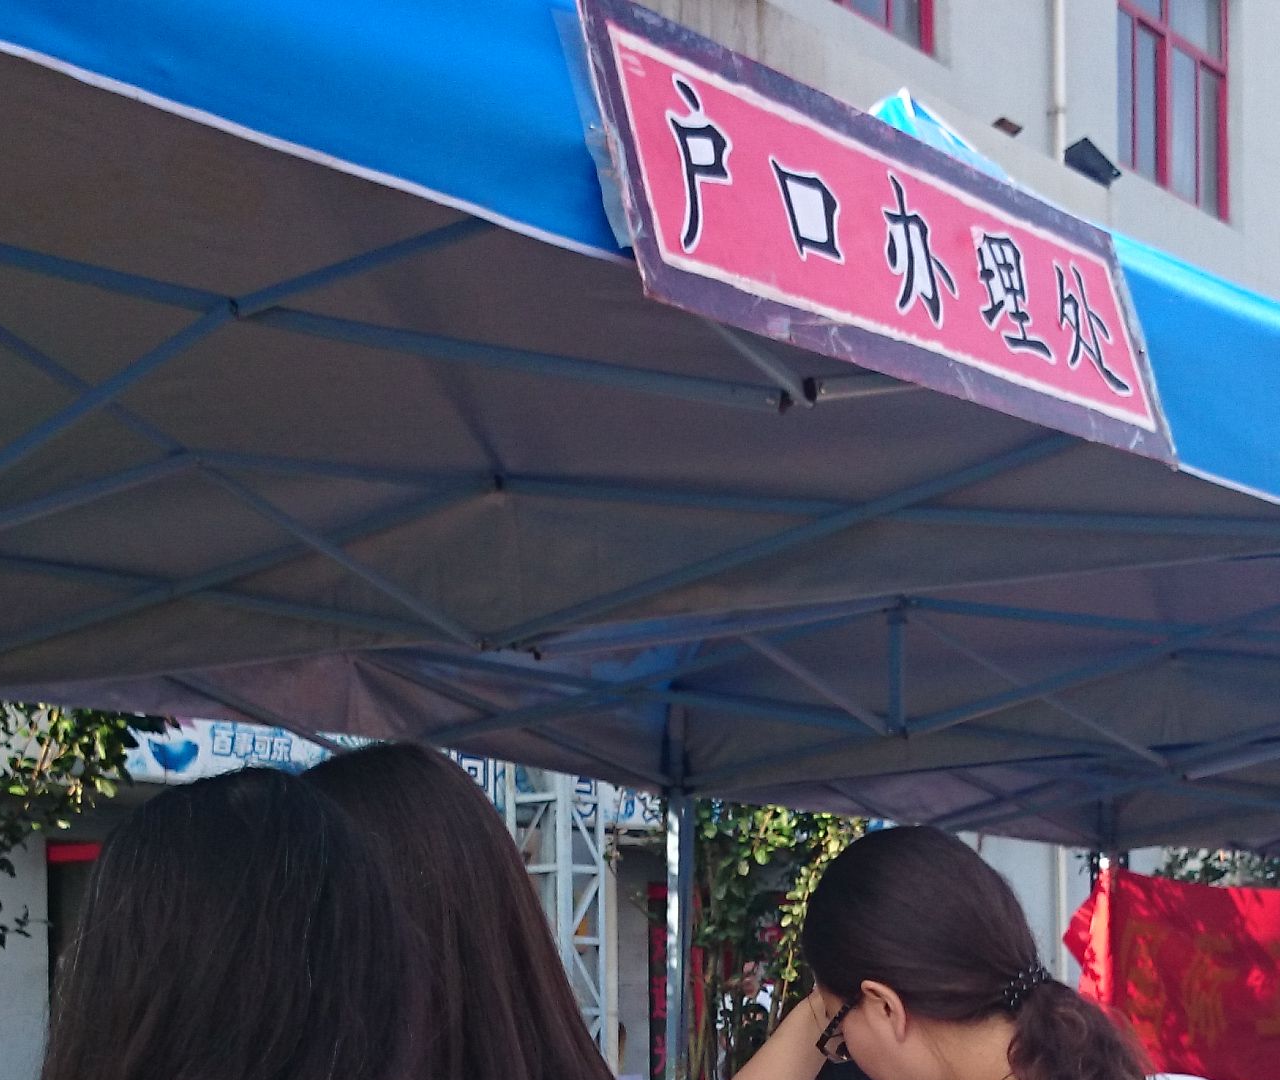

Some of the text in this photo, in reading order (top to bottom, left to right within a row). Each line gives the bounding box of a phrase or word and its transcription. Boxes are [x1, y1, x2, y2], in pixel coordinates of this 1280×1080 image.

[668, 74, 1131, 395] 户口办理处
